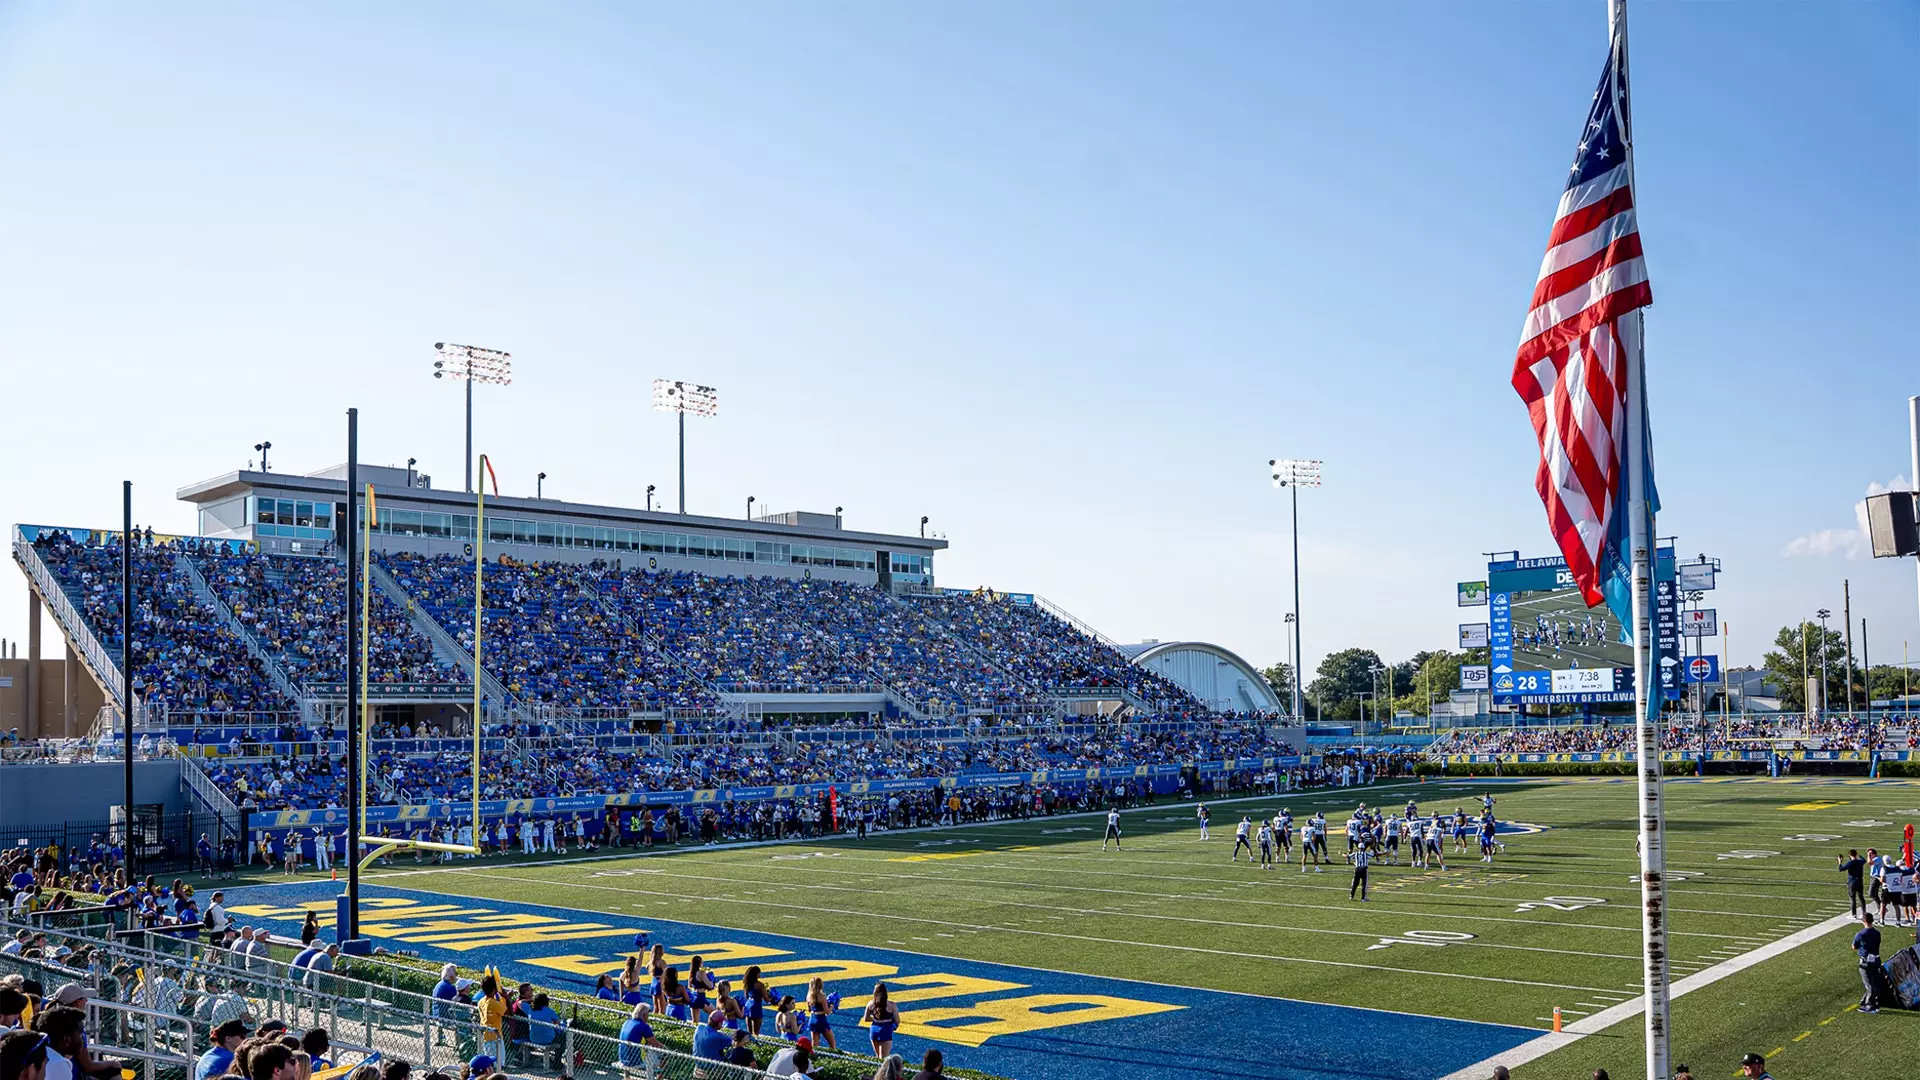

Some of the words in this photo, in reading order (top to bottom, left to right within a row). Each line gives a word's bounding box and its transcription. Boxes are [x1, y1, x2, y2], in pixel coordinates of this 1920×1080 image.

[1516, 557, 1566, 569] DELAWA
[1606, 541, 1632, 583] DECEMBER
[1556, 572, 1573, 584] DE
[1694, 612, 1704, 621] N
[1518, 676, 1537, 690] 28
[1579, 672, 1599, 681] 7:38
[1521, 694, 1577, 703] UNIVERSITY
[1596, 693, 1636, 702] DELAWA
[1518, 896, 1607, 911] 20
[1379, 930, 1474, 946] 10
[515, 942, 1190, 1048] BLUE
